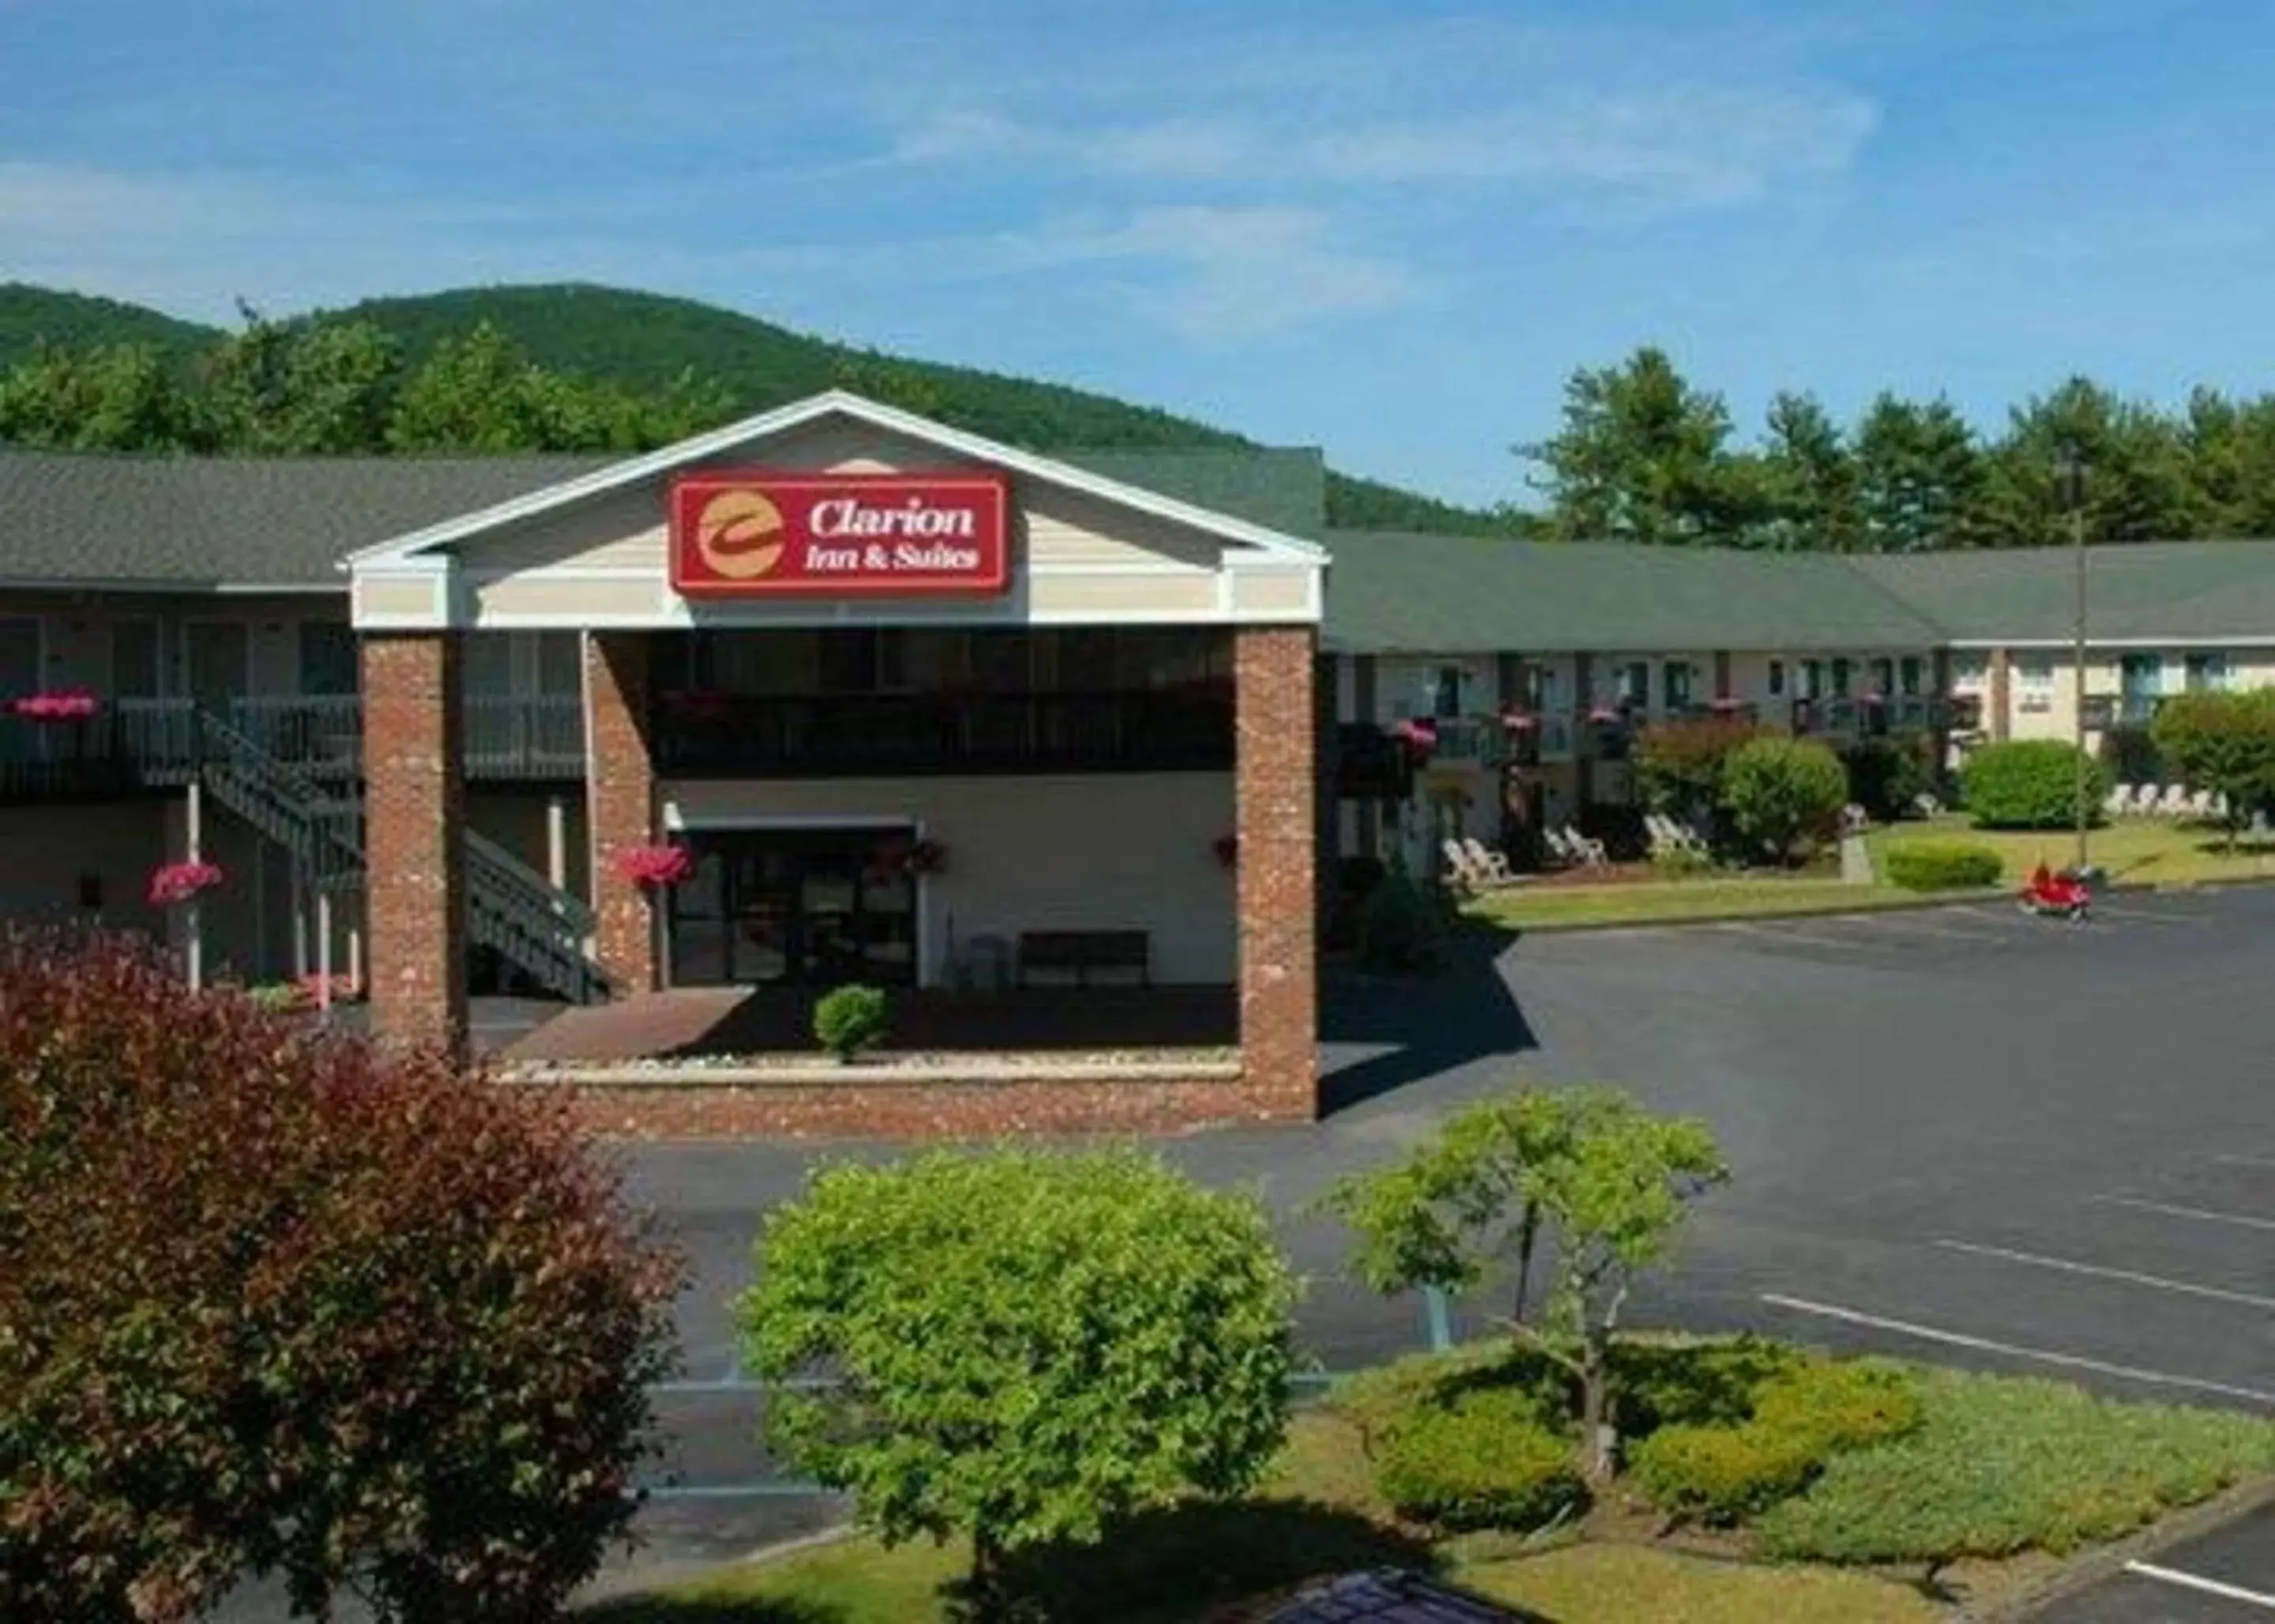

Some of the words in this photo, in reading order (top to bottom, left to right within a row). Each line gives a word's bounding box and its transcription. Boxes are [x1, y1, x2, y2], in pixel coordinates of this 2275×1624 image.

[810, 497, 974, 537] Clarion
[804, 546, 857, 570] Inn
[863, 543, 889, 570] &
[893, 543, 980, 570] Suites
